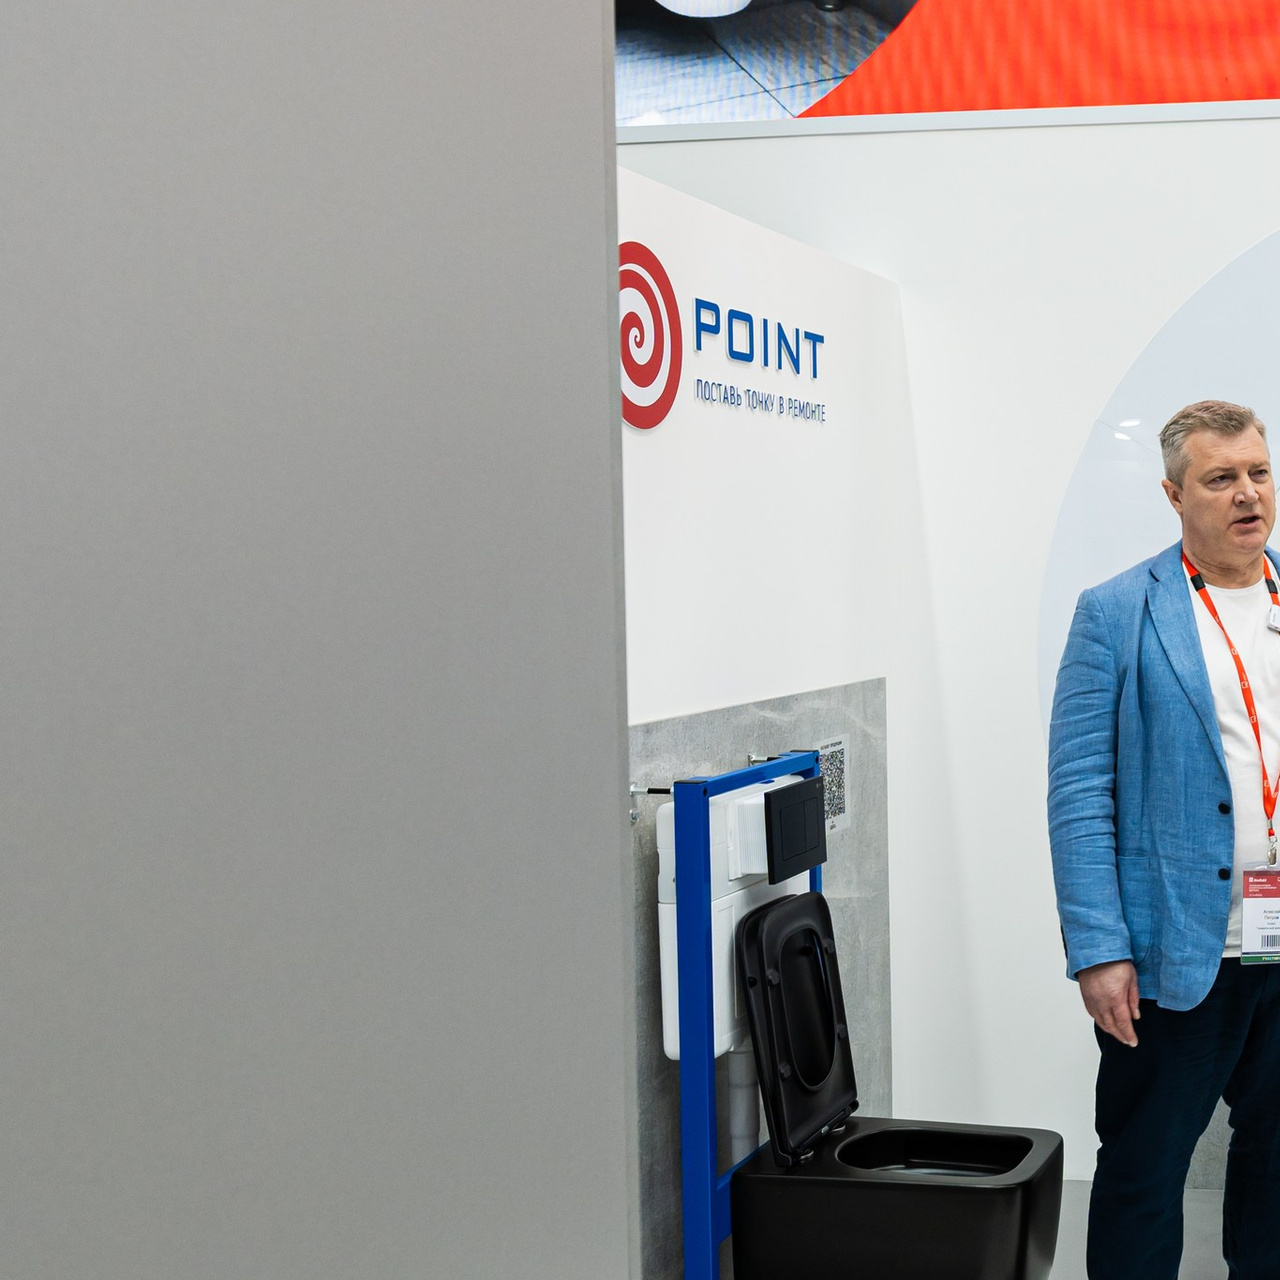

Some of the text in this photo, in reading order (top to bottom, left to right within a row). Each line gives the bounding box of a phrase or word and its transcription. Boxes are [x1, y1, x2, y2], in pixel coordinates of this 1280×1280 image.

[694, 297, 825, 380] POINT
[695, 378, 826, 422] ПОСТАВЬ ТОЧКУ В РЕМОНТЕ
